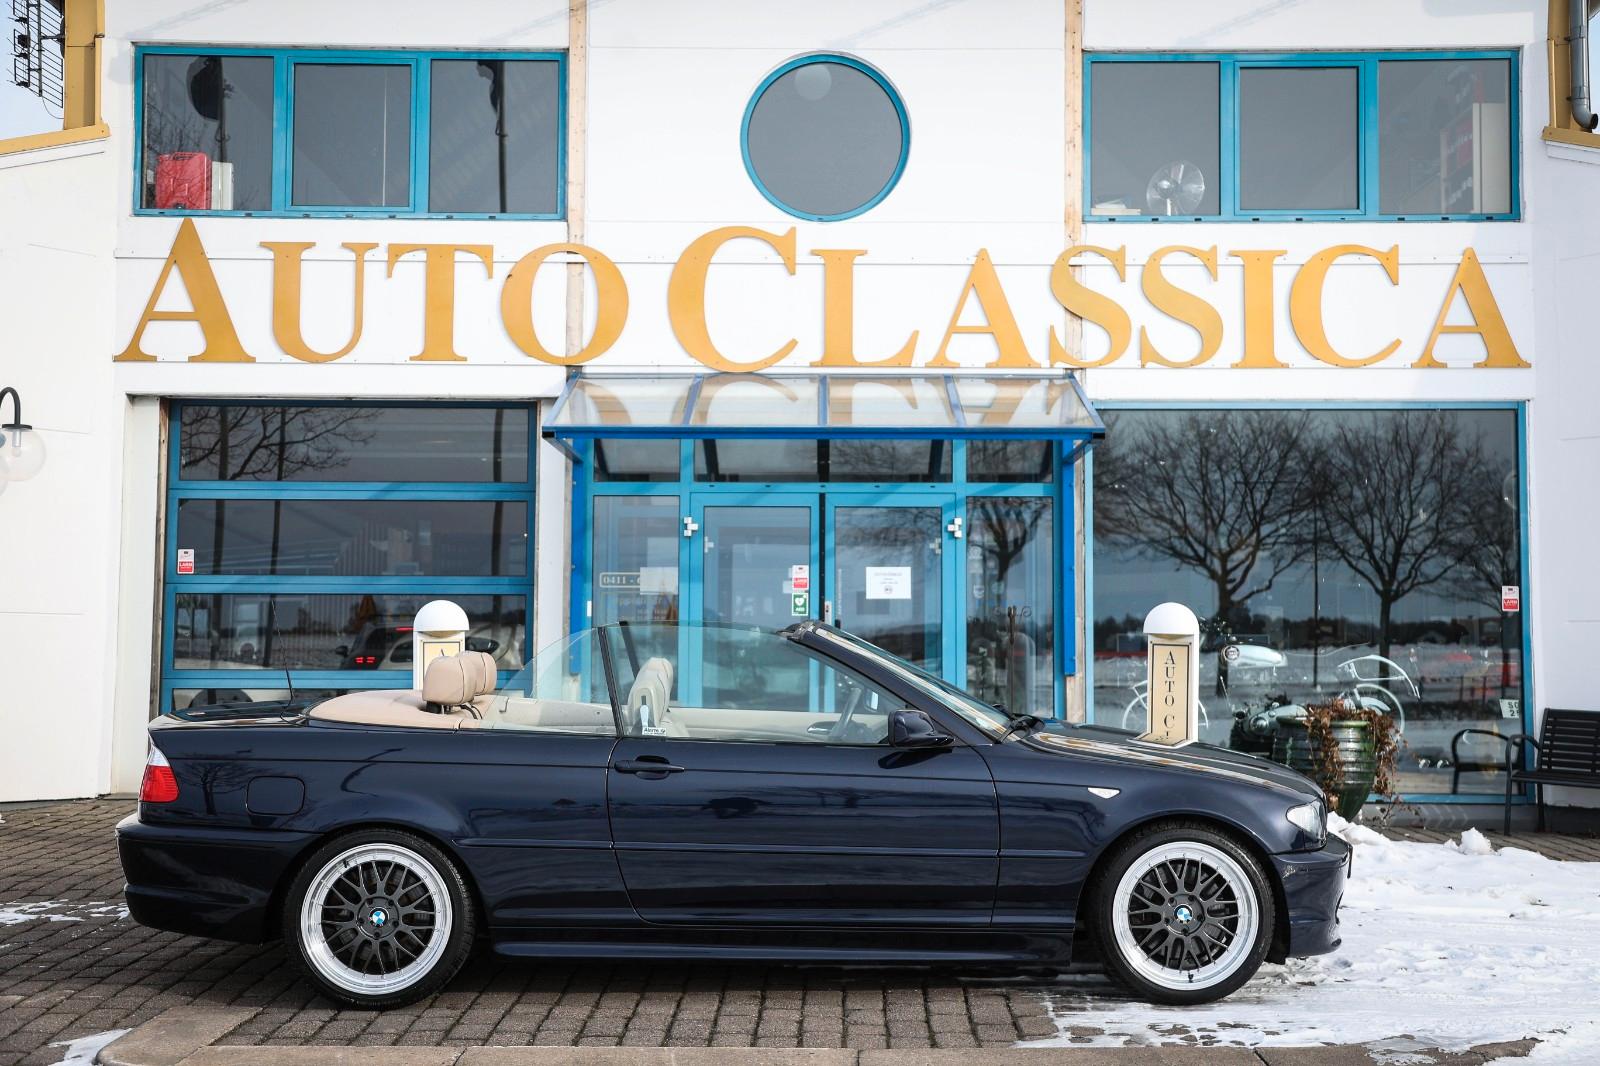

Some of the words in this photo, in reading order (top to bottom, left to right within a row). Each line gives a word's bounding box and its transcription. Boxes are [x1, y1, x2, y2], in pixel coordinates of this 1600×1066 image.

[113, 217, 629, 366] AUTO
[667, 226, 1531, 373] CLASSICA
[1164, 650, 1176, 707] AUTO
